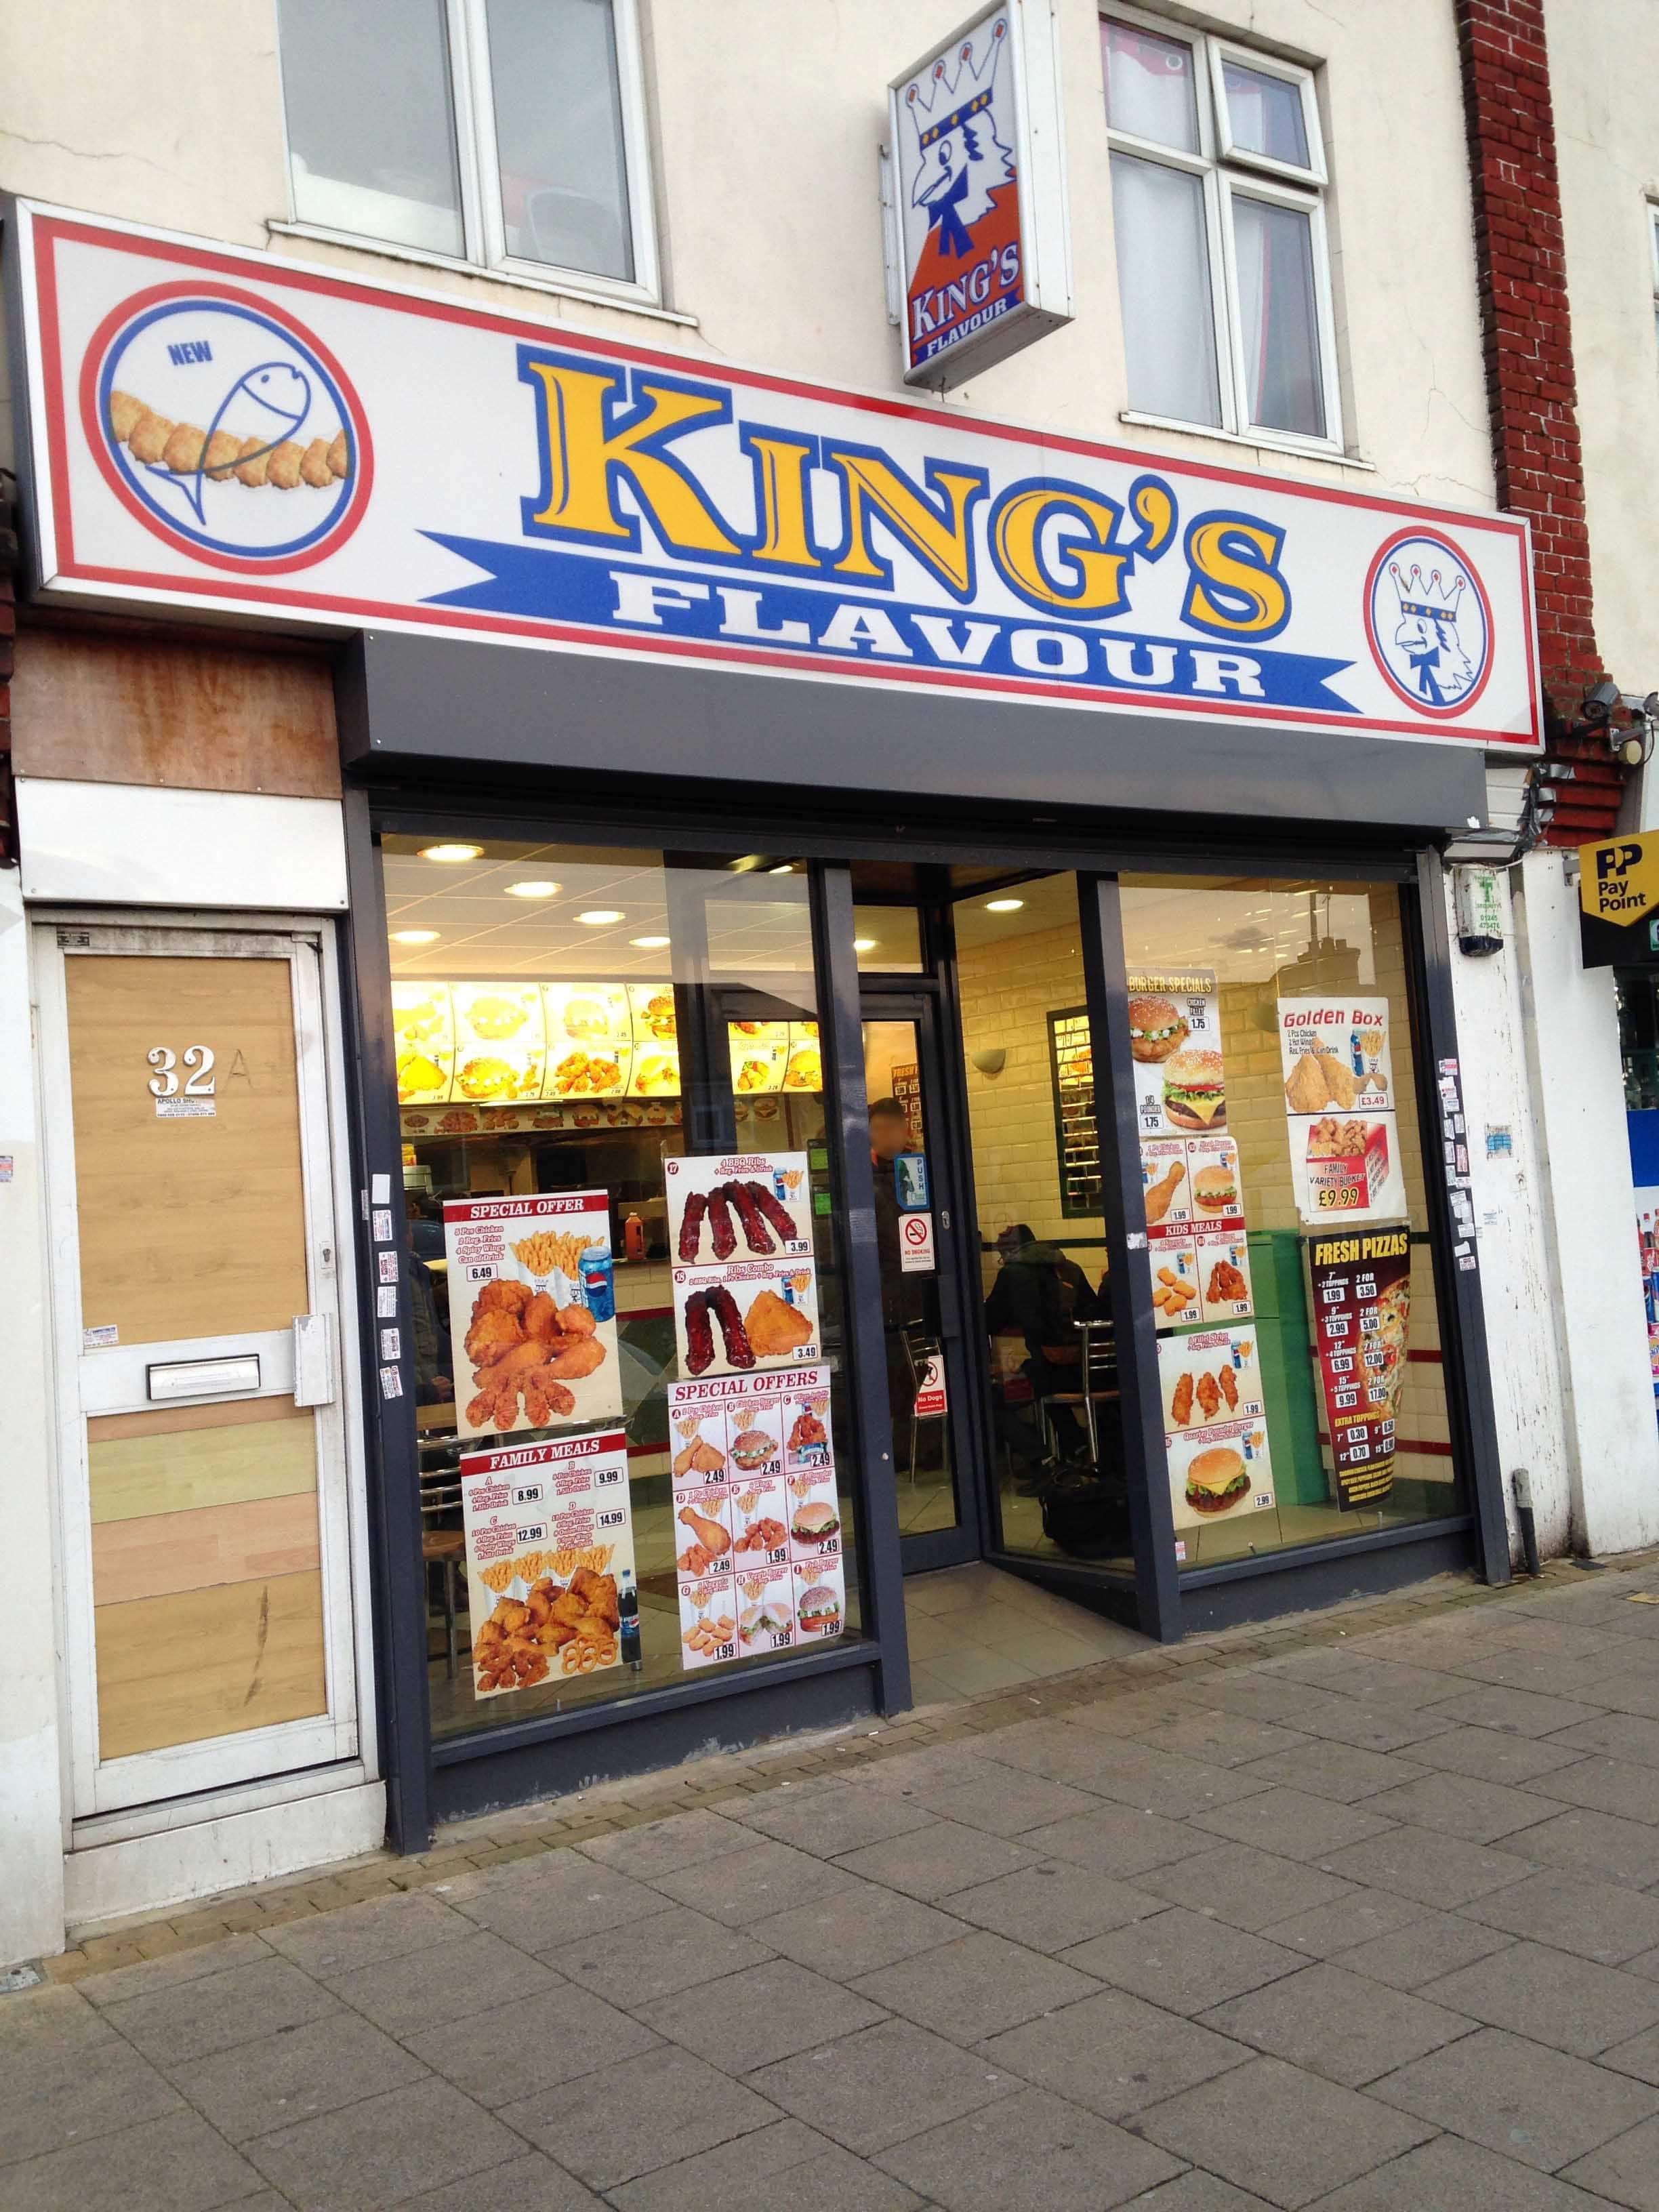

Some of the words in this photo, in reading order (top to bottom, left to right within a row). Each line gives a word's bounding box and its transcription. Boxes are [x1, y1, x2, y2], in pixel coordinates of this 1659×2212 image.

[912, 241, 1019, 341] KING'S
[927, 298, 1008, 356] FLAVOUR
[168, 341, 213, 365] NEW
[516, 344, 1292, 641] KING'S
[609, 571, 1266, 696] FLAVOUR
[1598, 880, 1628, 897] Pay
[1599, 893, 1646, 912] Point
[1128, 976, 1166, 992] BURGER
[1168, 976, 1212, 993] SPECIALS
[1284, 1009, 1345, 1027] Golden
[1353, 1010, 1382, 1026] Box
[1192, 1019, 1205, 1029] 1.75
[148, 1045, 215, 1097] 32
[1361, 1097, 1384, 1105] £3.49
[1145, 1118, 1159, 1127] 1.75
[728, 1158, 747, 1167] BBQ
[748, 1157, 766, 1166] Ribs
[756, 1165, 773, 1173] Drink
[1324, 1164, 1347, 1173] FAMILY
[1310, 1176, 1337, 1187] VARIETY
[1340, 1173, 1366, 1185] BUCKET
[1319, 1189, 1357, 1206] £9.99
[471, 1202, 532, 1218] SPECIAL
[537, 1198, 584, 1214] OFFER
[1226, 1206, 1237, 1214] 1.99
[1174, 1211, 1186, 1220] 1.99
[474, 1225, 504, 1233] Chicken
[1166, 1224, 1188, 1236] KIDS
[1191, 1221, 1222, 1232] MEALS
[483, 1235, 501, 1243] Fries
[462, 1245, 480, 1255] Spicy
[483, 1244, 505, 1253] Wings
[791, 1242, 808, 1252] 3.99
[1315, 1240, 1359, 1266] FRESH
[1362, 1233, 1408, 1260] PIZZAS
[472, 1268, 491, 1279] 6.49
[727, 1265, 745, 1275] Ribs
[747, 1263, 774, 1272] Combo
[735, 1273, 757, 1282] Chicken
[1361, 1273, 1374, 1282] FOR
[1327, 1291, 1340, 1300] 1.99
[1360, 1285, 1374, 1296] 3.50
[1236, 1304, 1248, 1313] 1.99
[1366, 1307, 1377, 1315] FOR
[1185, 1311, 1197, 1319] 1.99
[1330, 1324, 1345, 1335] 2.99
[1364, 1318, 1378, 1330] 5.00
[798, 1347, 815, 1357] 3.49
[1334, 1359, 1349, 1370] 6.99
[1366, 1354, 1382, 1365] 12.00
[675, 1380, 747, 1401] SPECIAL
[754, 1371, 818, 1390] OFFERS
[1370, 1387, 1385, 1400] 17.00
[1339, 1394, 1355, 1406] 9.99
[1246, 1405, 1258, 1414] 1.99
[1334, 1416, 1352, 1427] EXTRA
[1183, 1430, 1207, 1441] Quarter
[1208, 1425, 1233, 1436] Pounder
[1233, 1422, 1254, 1431] Burger
[1350, 1429, 1365, 1439] 0.30
[490, 1448, 548, 1469] FAMILY
[551, 1439, 599, 1460] MEALS
[1353, 1446, 1366, 1458] 0.70
[812, 1454, 830, 1467] 2.49
[762, 1462, 780, 1475] 2.49
[485, 1476, 493, 1486] A
[599, 1471, 617, 1483] 9.99
[705, 1471, 724, 1483] 2.49
[486, 1484, 510, 1492] Chicken
[518, 1488, 538, 1501] 8.99
[491, 1499, 508, 1508] Drink
[569, 1502, 576, 1510] D
[1256, 1496, 1269, 1505] 2.99
[490, 1515, 497, 1525] C
[600, 1512, 622, 1525] 14.99
[493, 1523, 516, 1532] Chicken
[517, 1528, 541, 1541] 12.99
[495, 1548, 514, 1557] Drink
[819, 1541, 838, 1553] 2.49
[769, 1551, 786, 1563] 1.99
[714, 1561, 730, 1572] 2.49
[823, 1622, 840, 1635] 1.99
[773, 1635, 790, 1647] 1.99
[715, 1646, 734, 1659] 1.99
